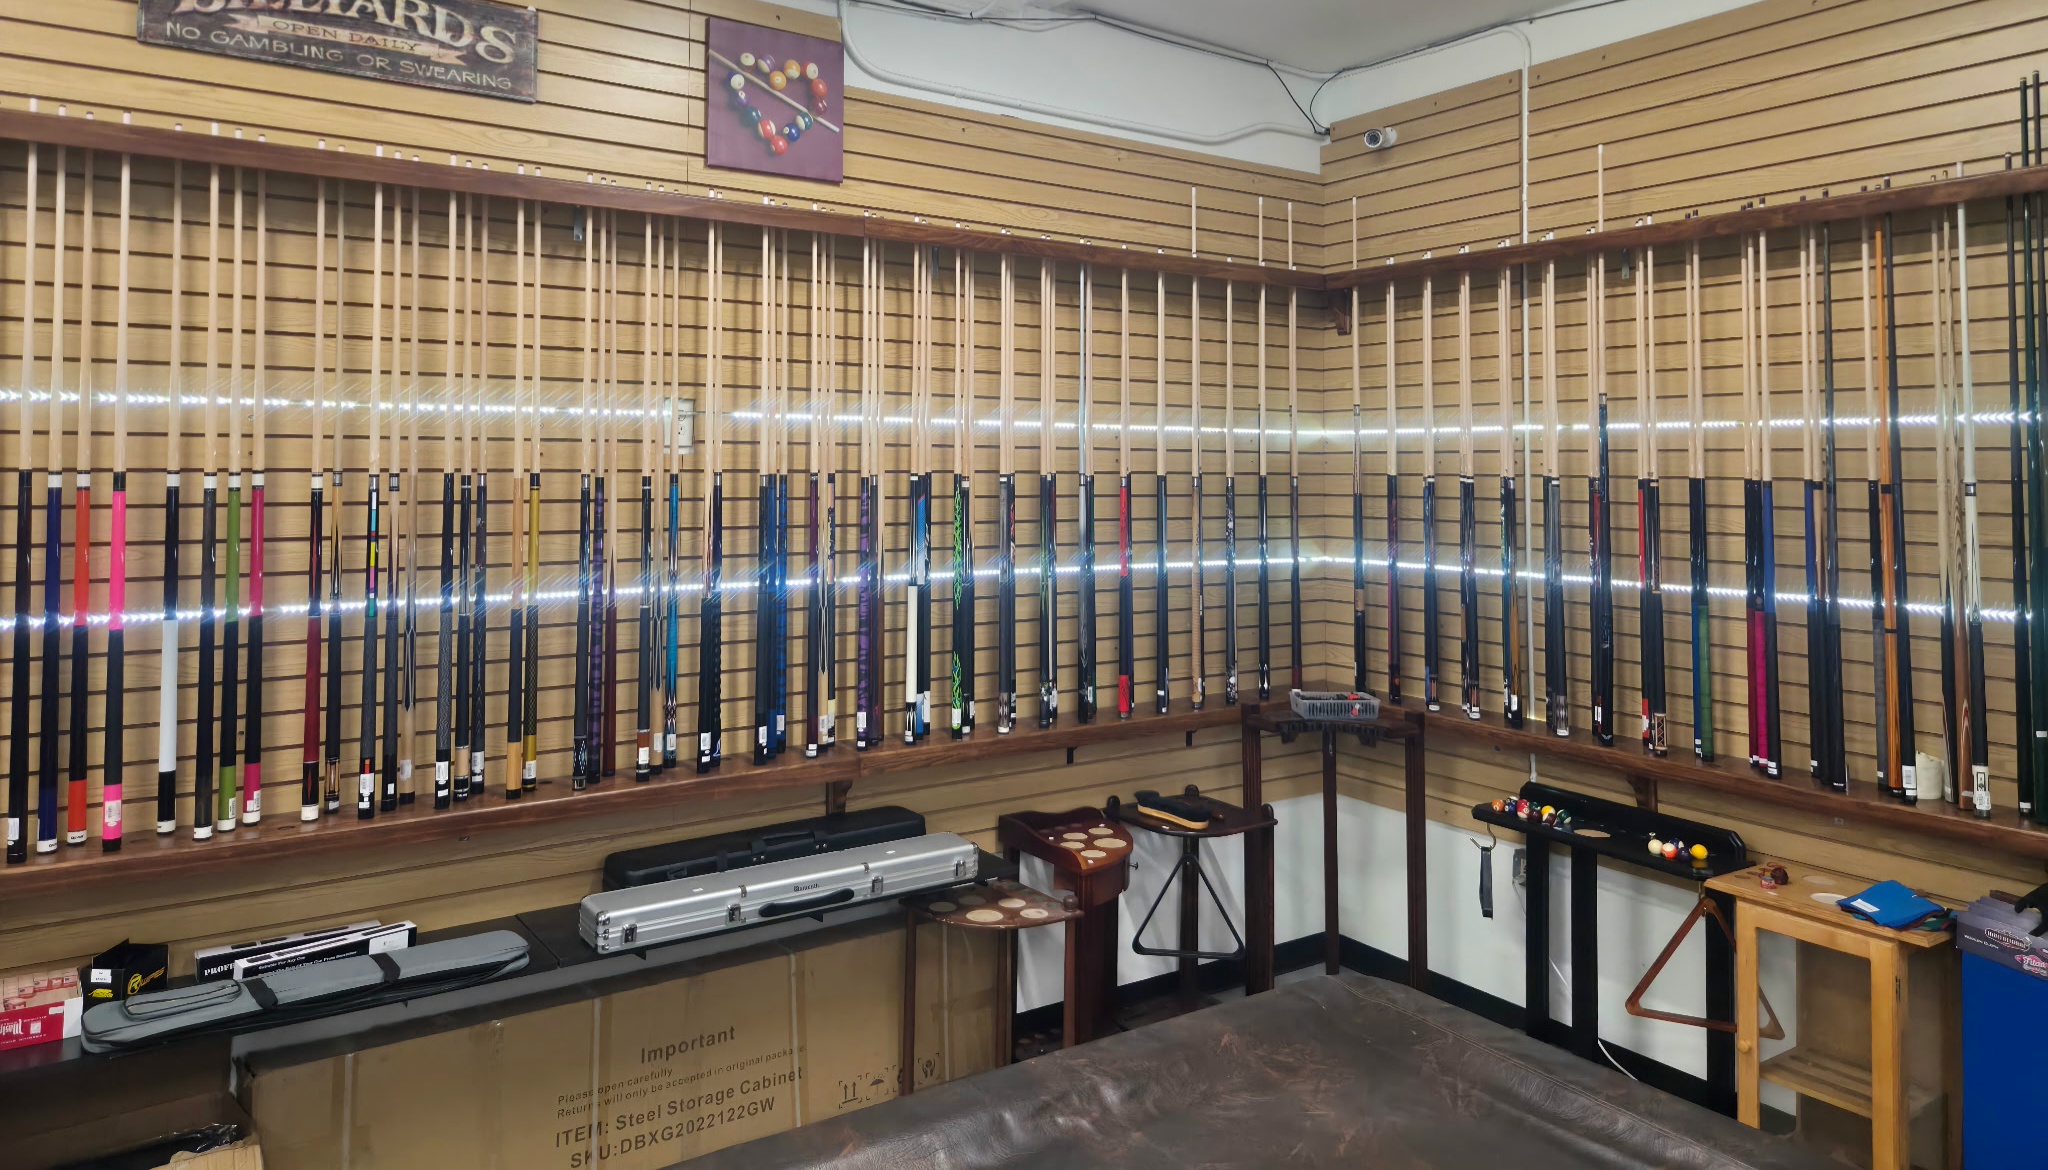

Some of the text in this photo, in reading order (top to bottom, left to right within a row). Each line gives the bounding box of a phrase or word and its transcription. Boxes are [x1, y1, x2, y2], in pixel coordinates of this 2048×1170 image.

[272, 20, 421, 51] OPEN DAILY
[210, 30, 344, 63] GAMBLING
[356, 54, 392, 71] OR
[399, 60, 512, 91] SWEARING
[641, 1026, 735, 1064] Important
[557, 1068, 673, 1105] Please open carefully
[604, 1092, 622, 1106] will
[625, 1087, 648, 1100] only
[651, 1084, 663, 1093] be
[665, 1068, 712, 1089] accepted
[714, 1066, 724, 1076] in
[726, 1055, 763, 1071] original
[765, 1044, 807, 1064] packae.
[555, 1066, 803, 1148] ITEM: Steel Storage Cabinet
